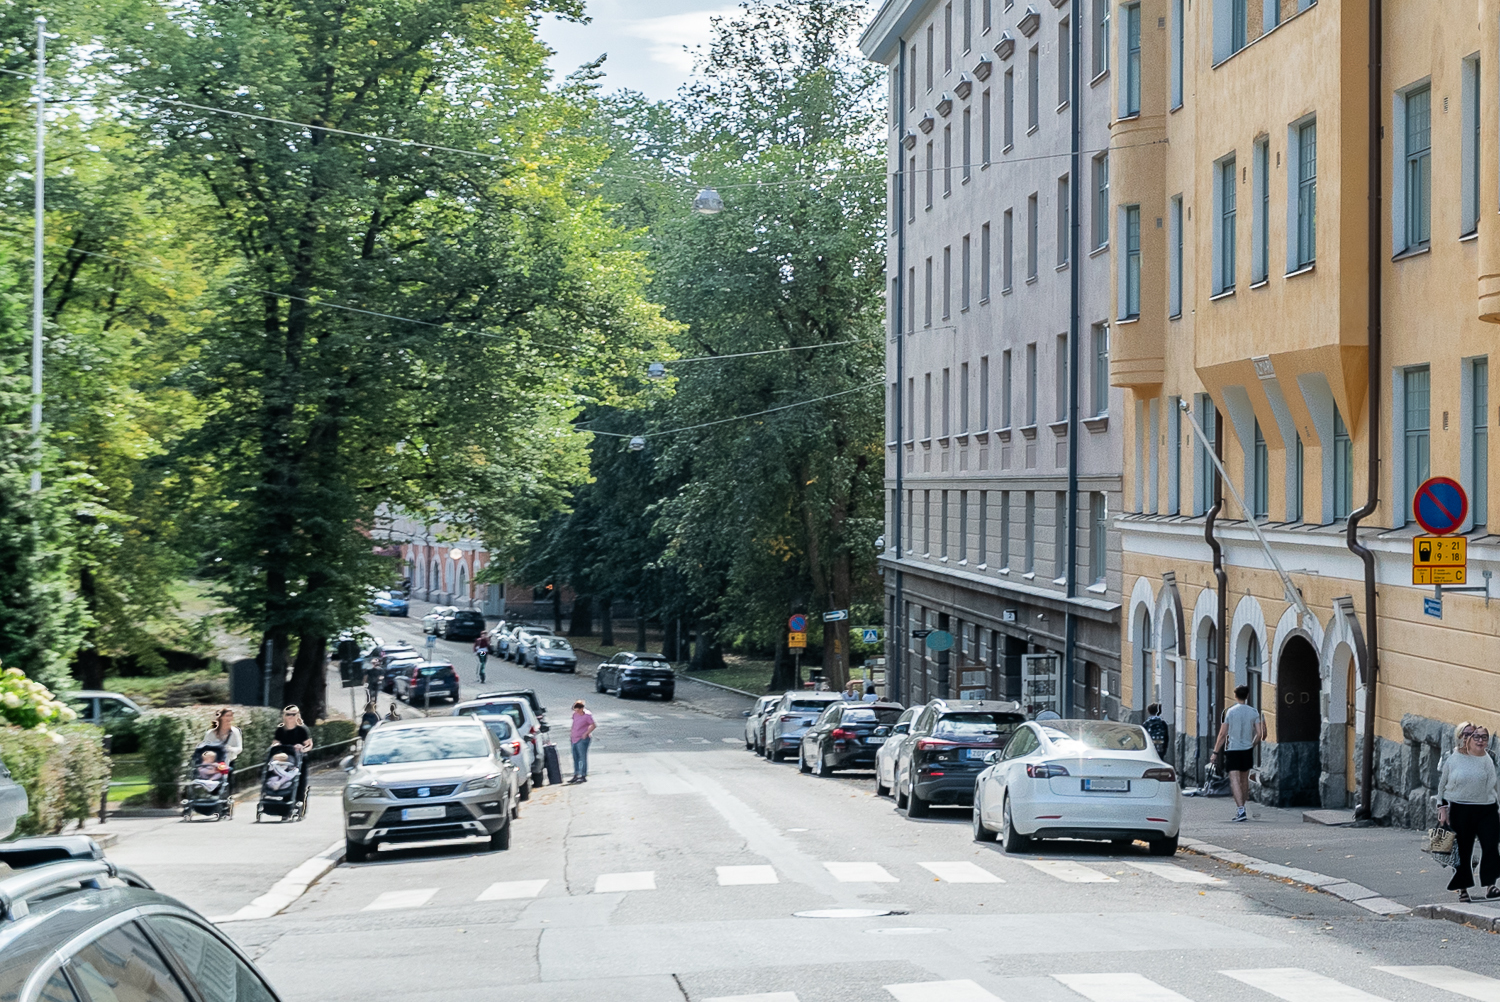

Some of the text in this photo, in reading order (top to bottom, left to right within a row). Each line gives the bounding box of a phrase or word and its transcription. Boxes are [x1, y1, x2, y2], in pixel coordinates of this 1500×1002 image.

[1437, 542, 1442, 550] 9
[1451, 542, 1460, 550] 21
[1421, 575, 1424, 583] 1
[1455, 570, 1463, 581] C
[1284, 691, 1310, 705] C D
